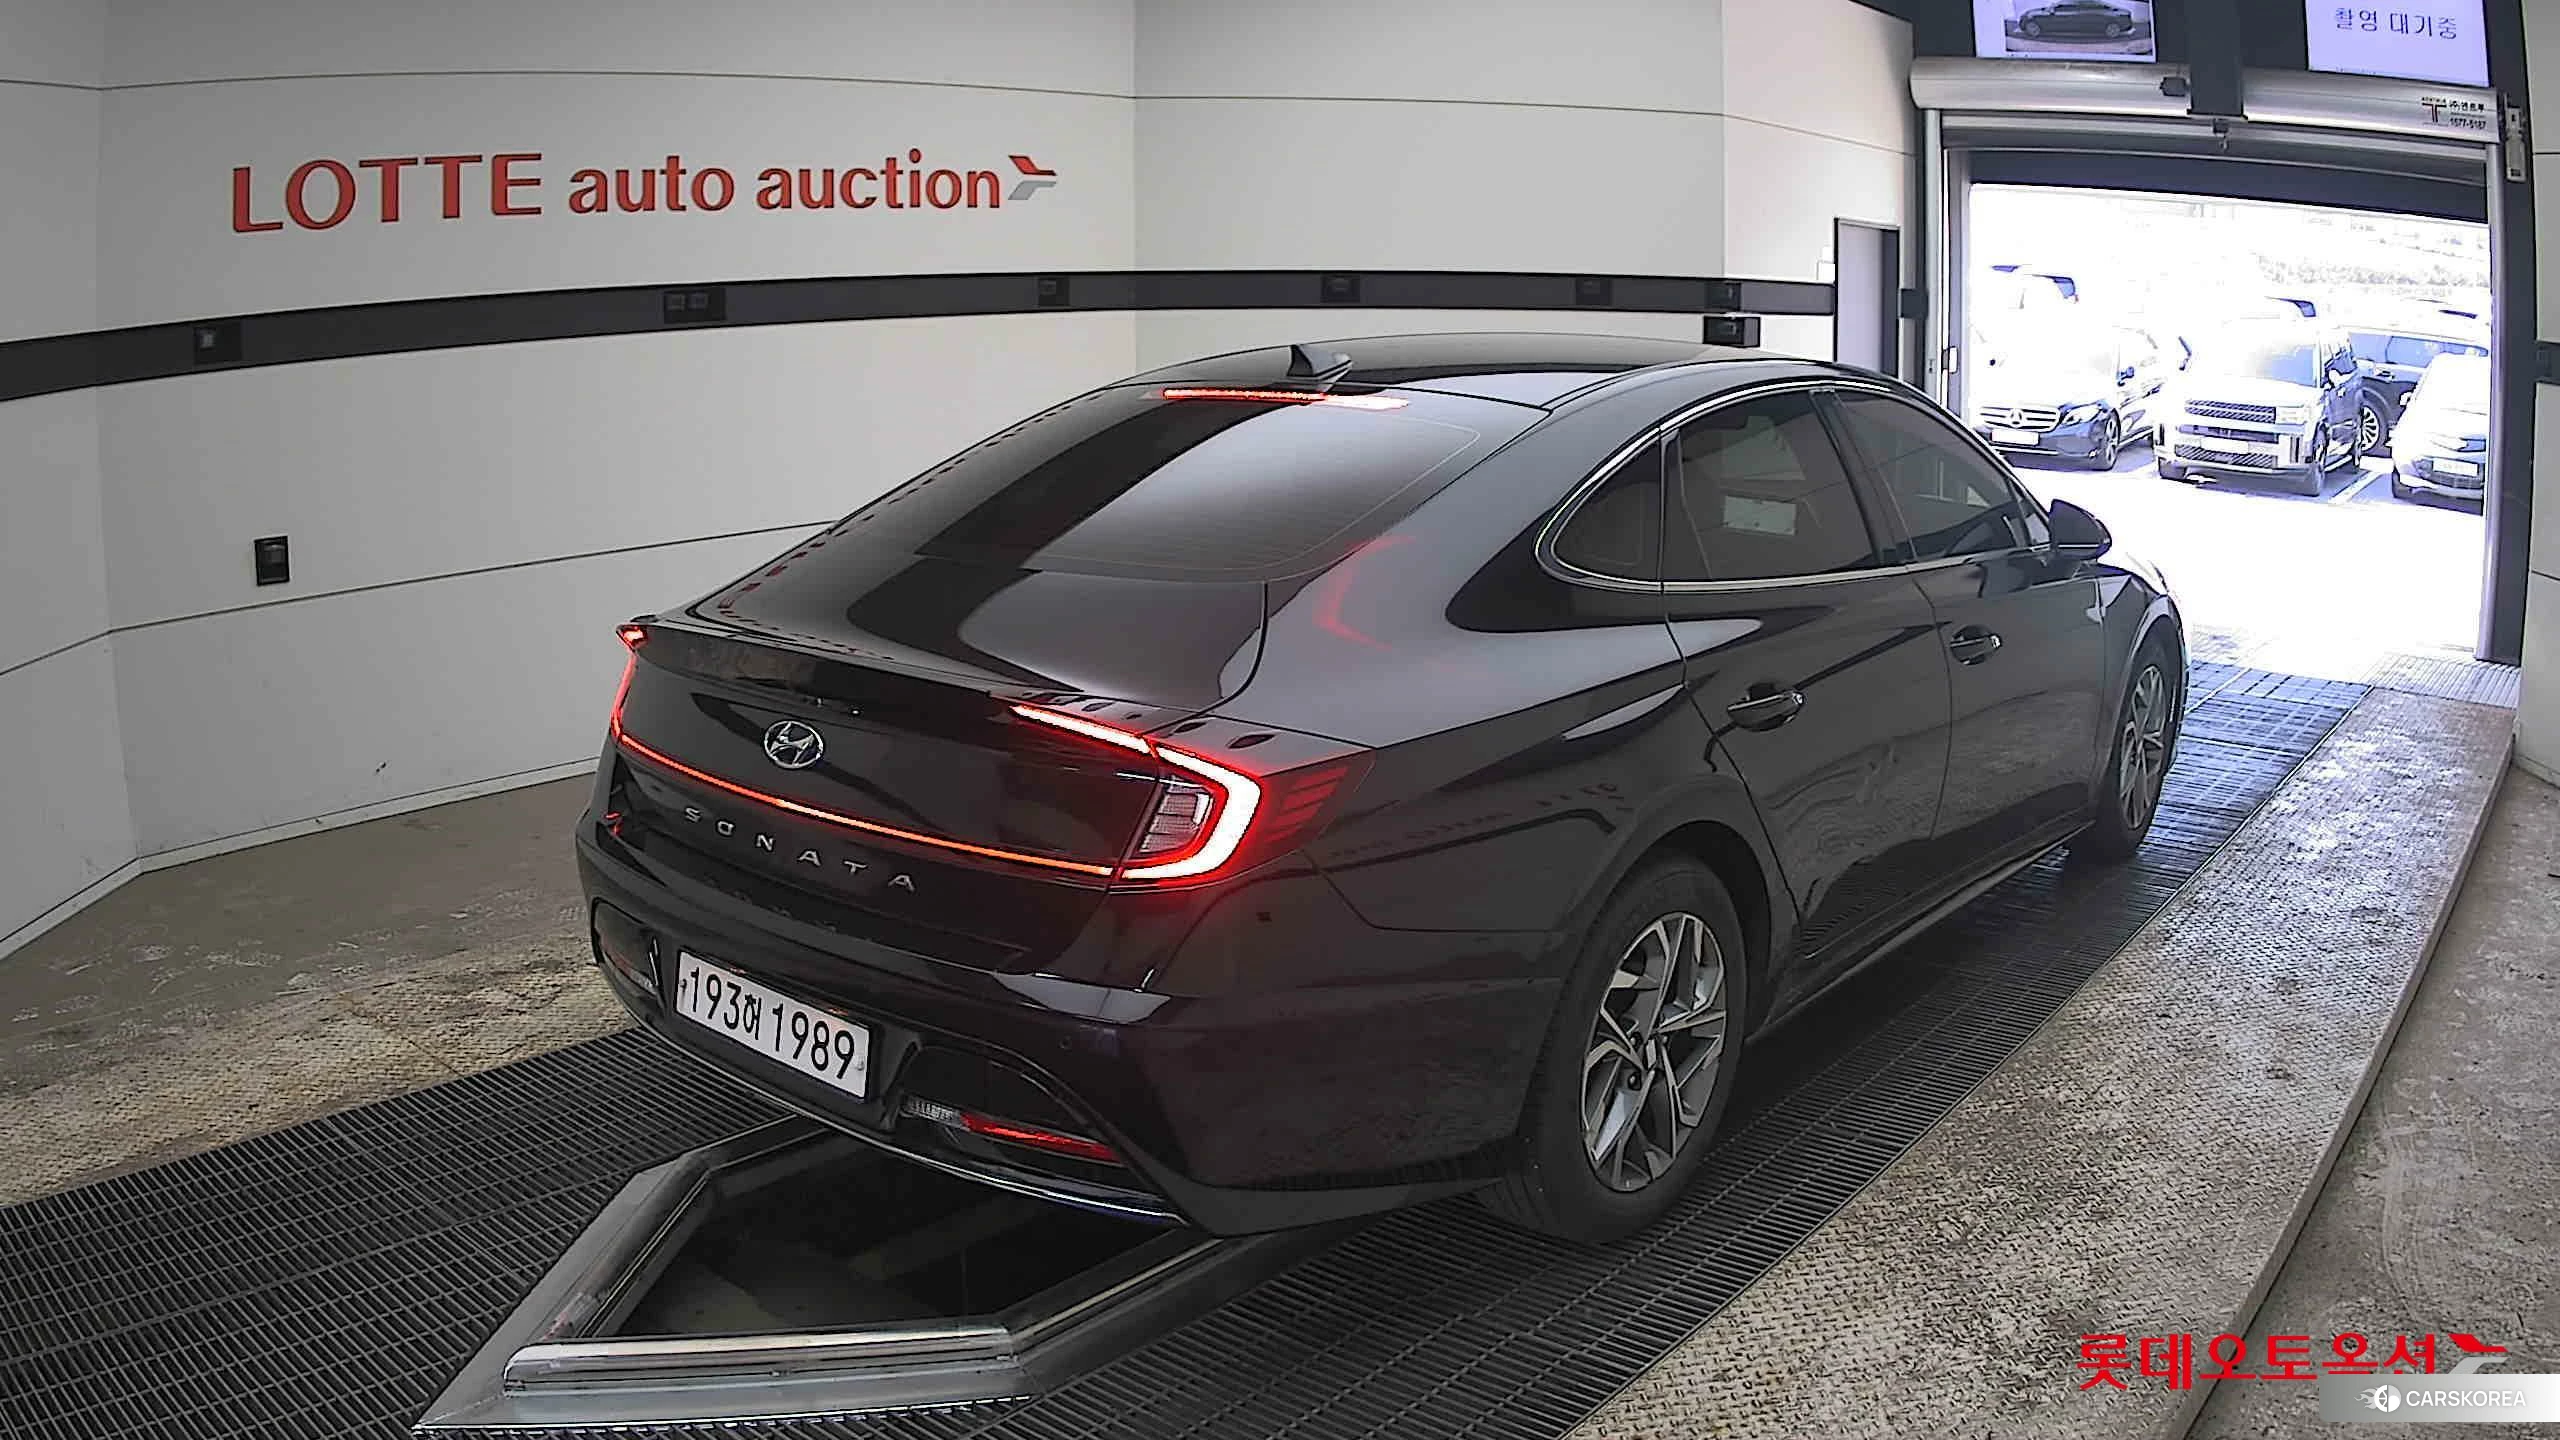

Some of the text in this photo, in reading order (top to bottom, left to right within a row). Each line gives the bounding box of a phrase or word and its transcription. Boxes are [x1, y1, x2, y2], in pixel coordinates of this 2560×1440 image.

[2390, 12, 2457, 40] 대기중
[233, 148, 1001, 233] LOTTE auto auction
[684, 806, 916, 892] SONATA
[772, 1002, 855, 1080] 1989
